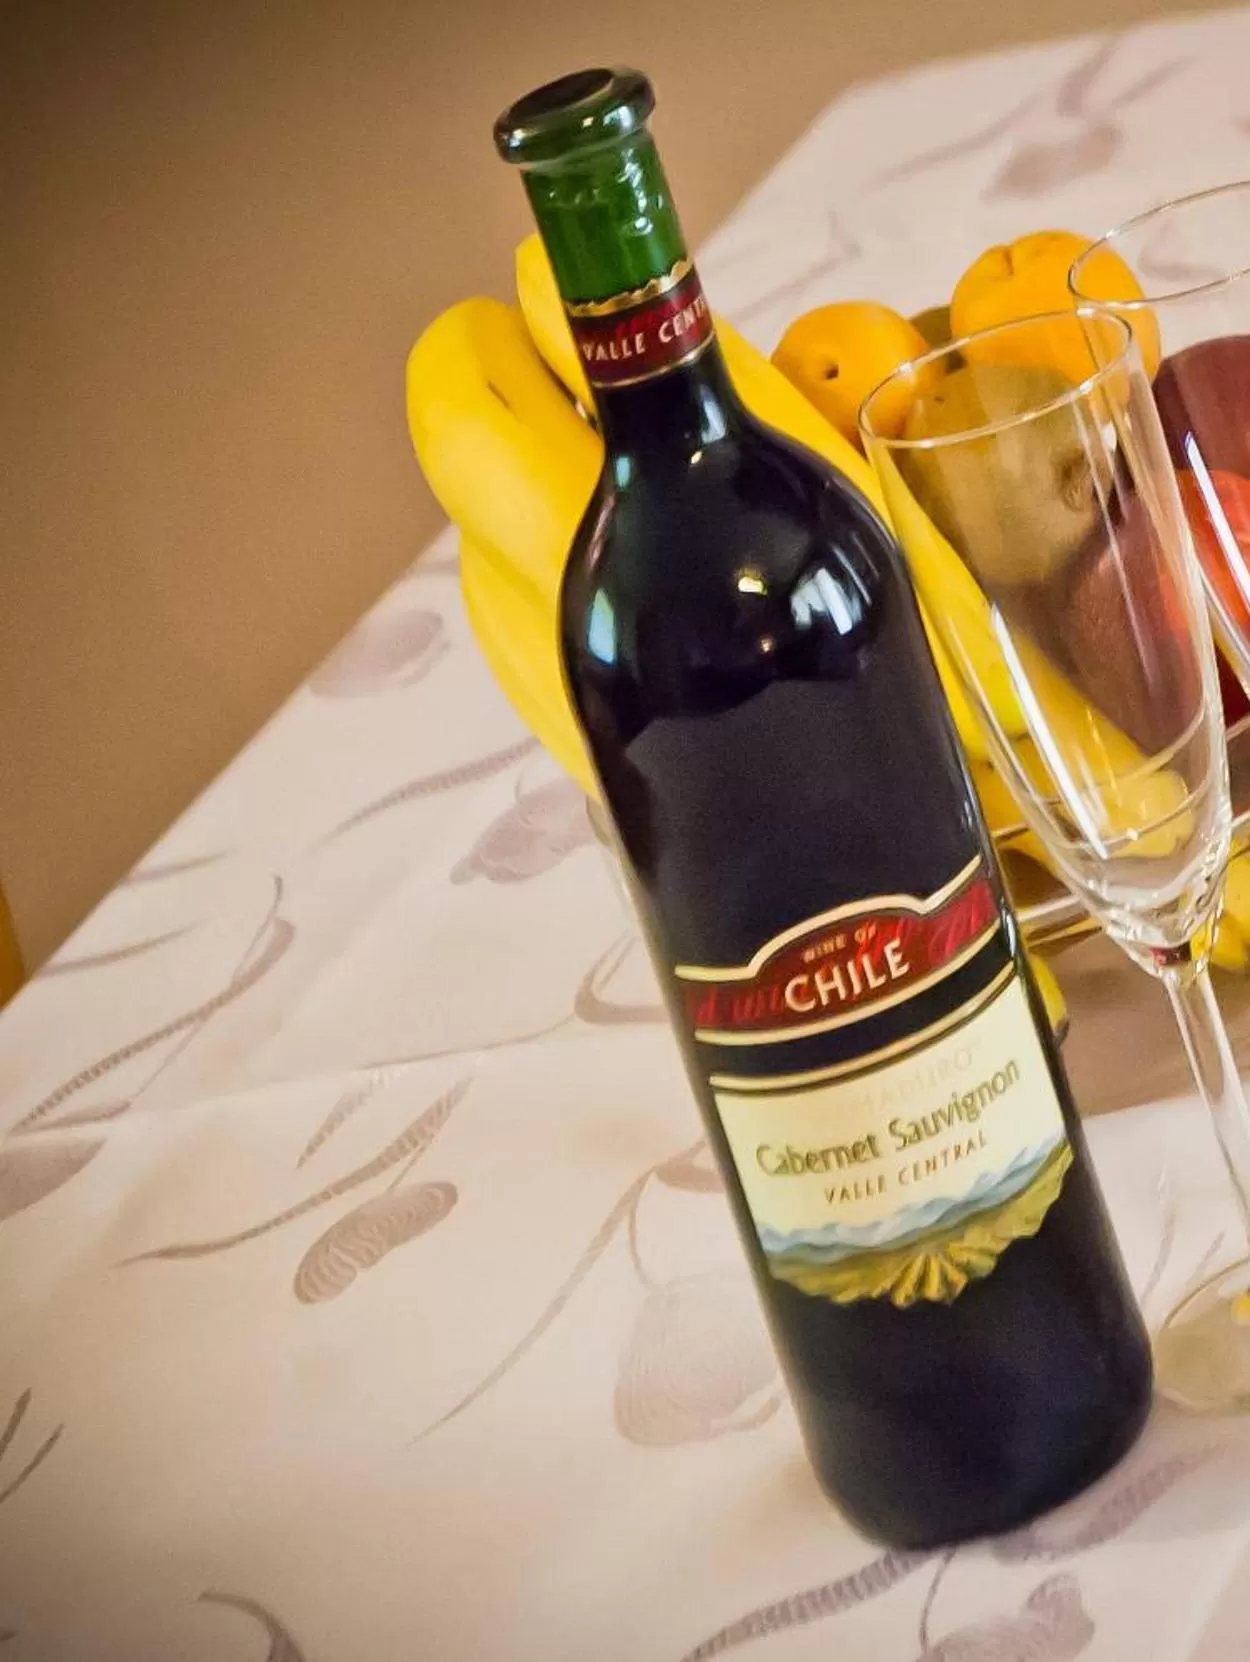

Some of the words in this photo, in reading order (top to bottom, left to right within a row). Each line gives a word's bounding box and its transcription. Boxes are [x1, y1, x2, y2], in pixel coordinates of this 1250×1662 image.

[582, 332, 646, 361] VALLE
[784, 938, 910, 1012] CHILE
[756, 1133, 880, 1177] Cabernet
[888, 1059, 1021, 1150] Sauvignon
[825, 1174, 886, 1205] VALLE
[899, 1129, 988, 1185] CENTRAL
